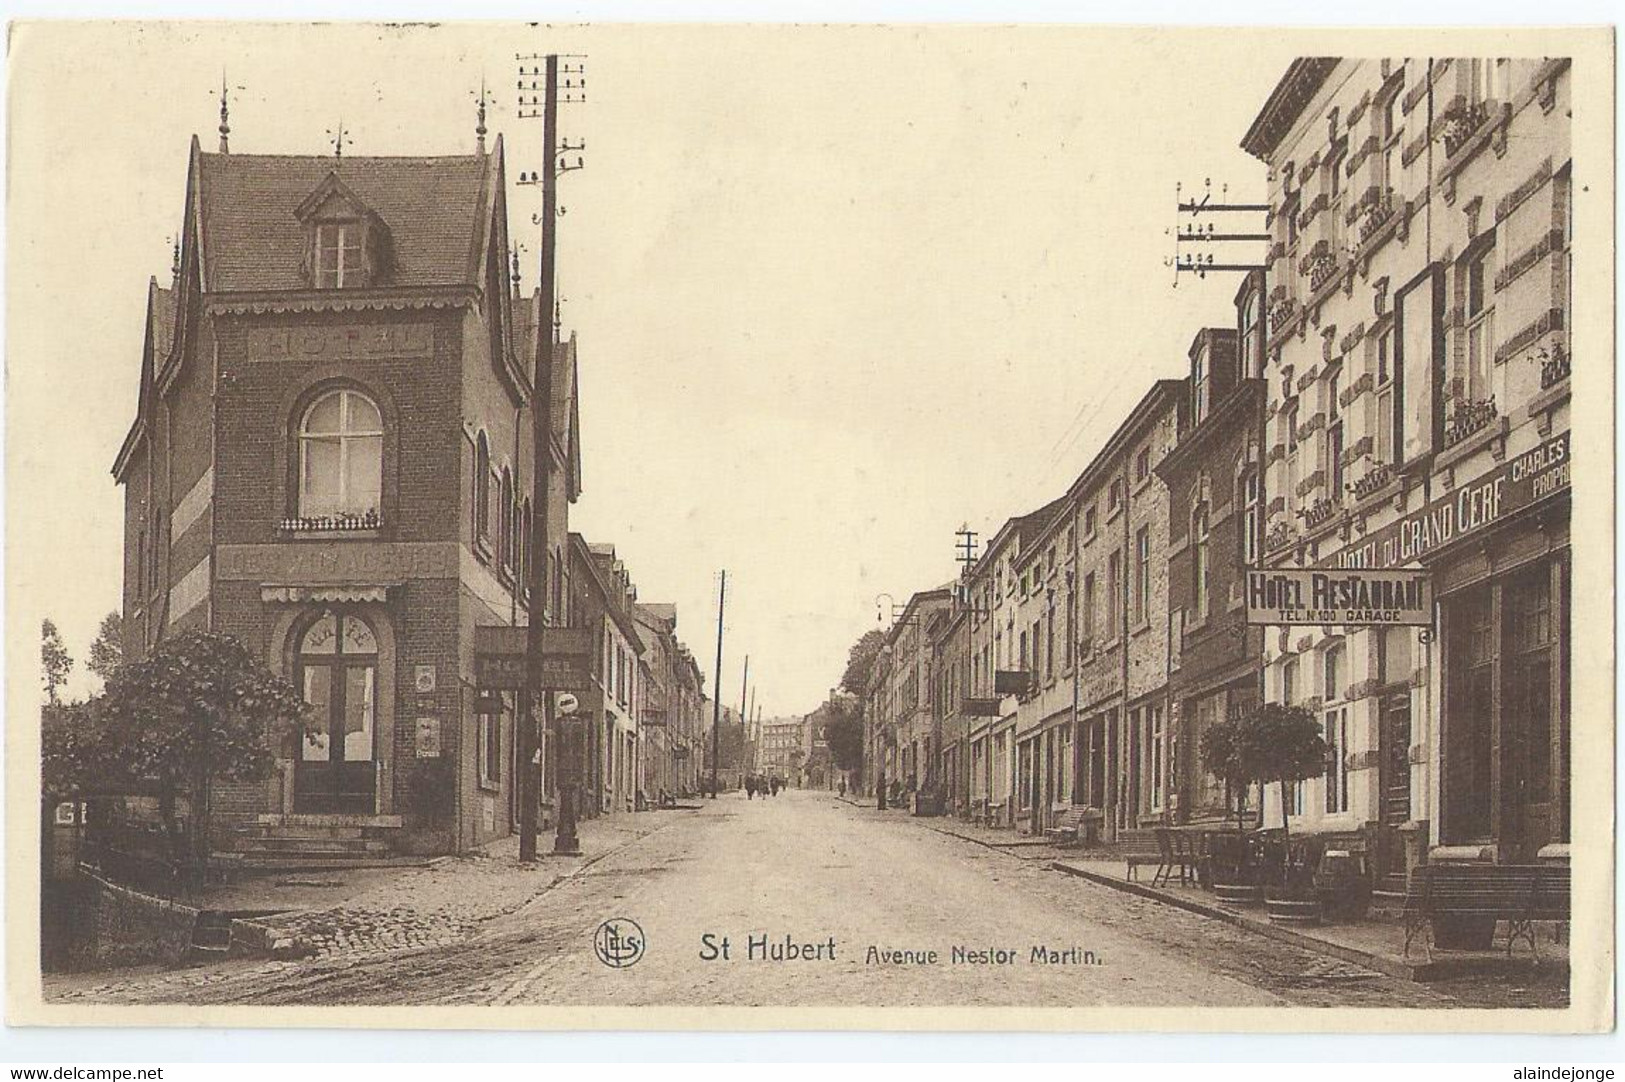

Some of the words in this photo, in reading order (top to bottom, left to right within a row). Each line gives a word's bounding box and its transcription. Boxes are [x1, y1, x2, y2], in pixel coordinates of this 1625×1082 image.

[1512, 438, 1564, 483] CHARLES
[1383, 536, 1398, 568] DU
[1400, 503, 1453, 560] GRAND
[1458, 475, 1506, 533] CERF
[1250, 573, 1306, 610] HOTEL
[1312, 573, 1426, 611] RESTAURANT
[1346, 609, 1401, 622] GARAGE
